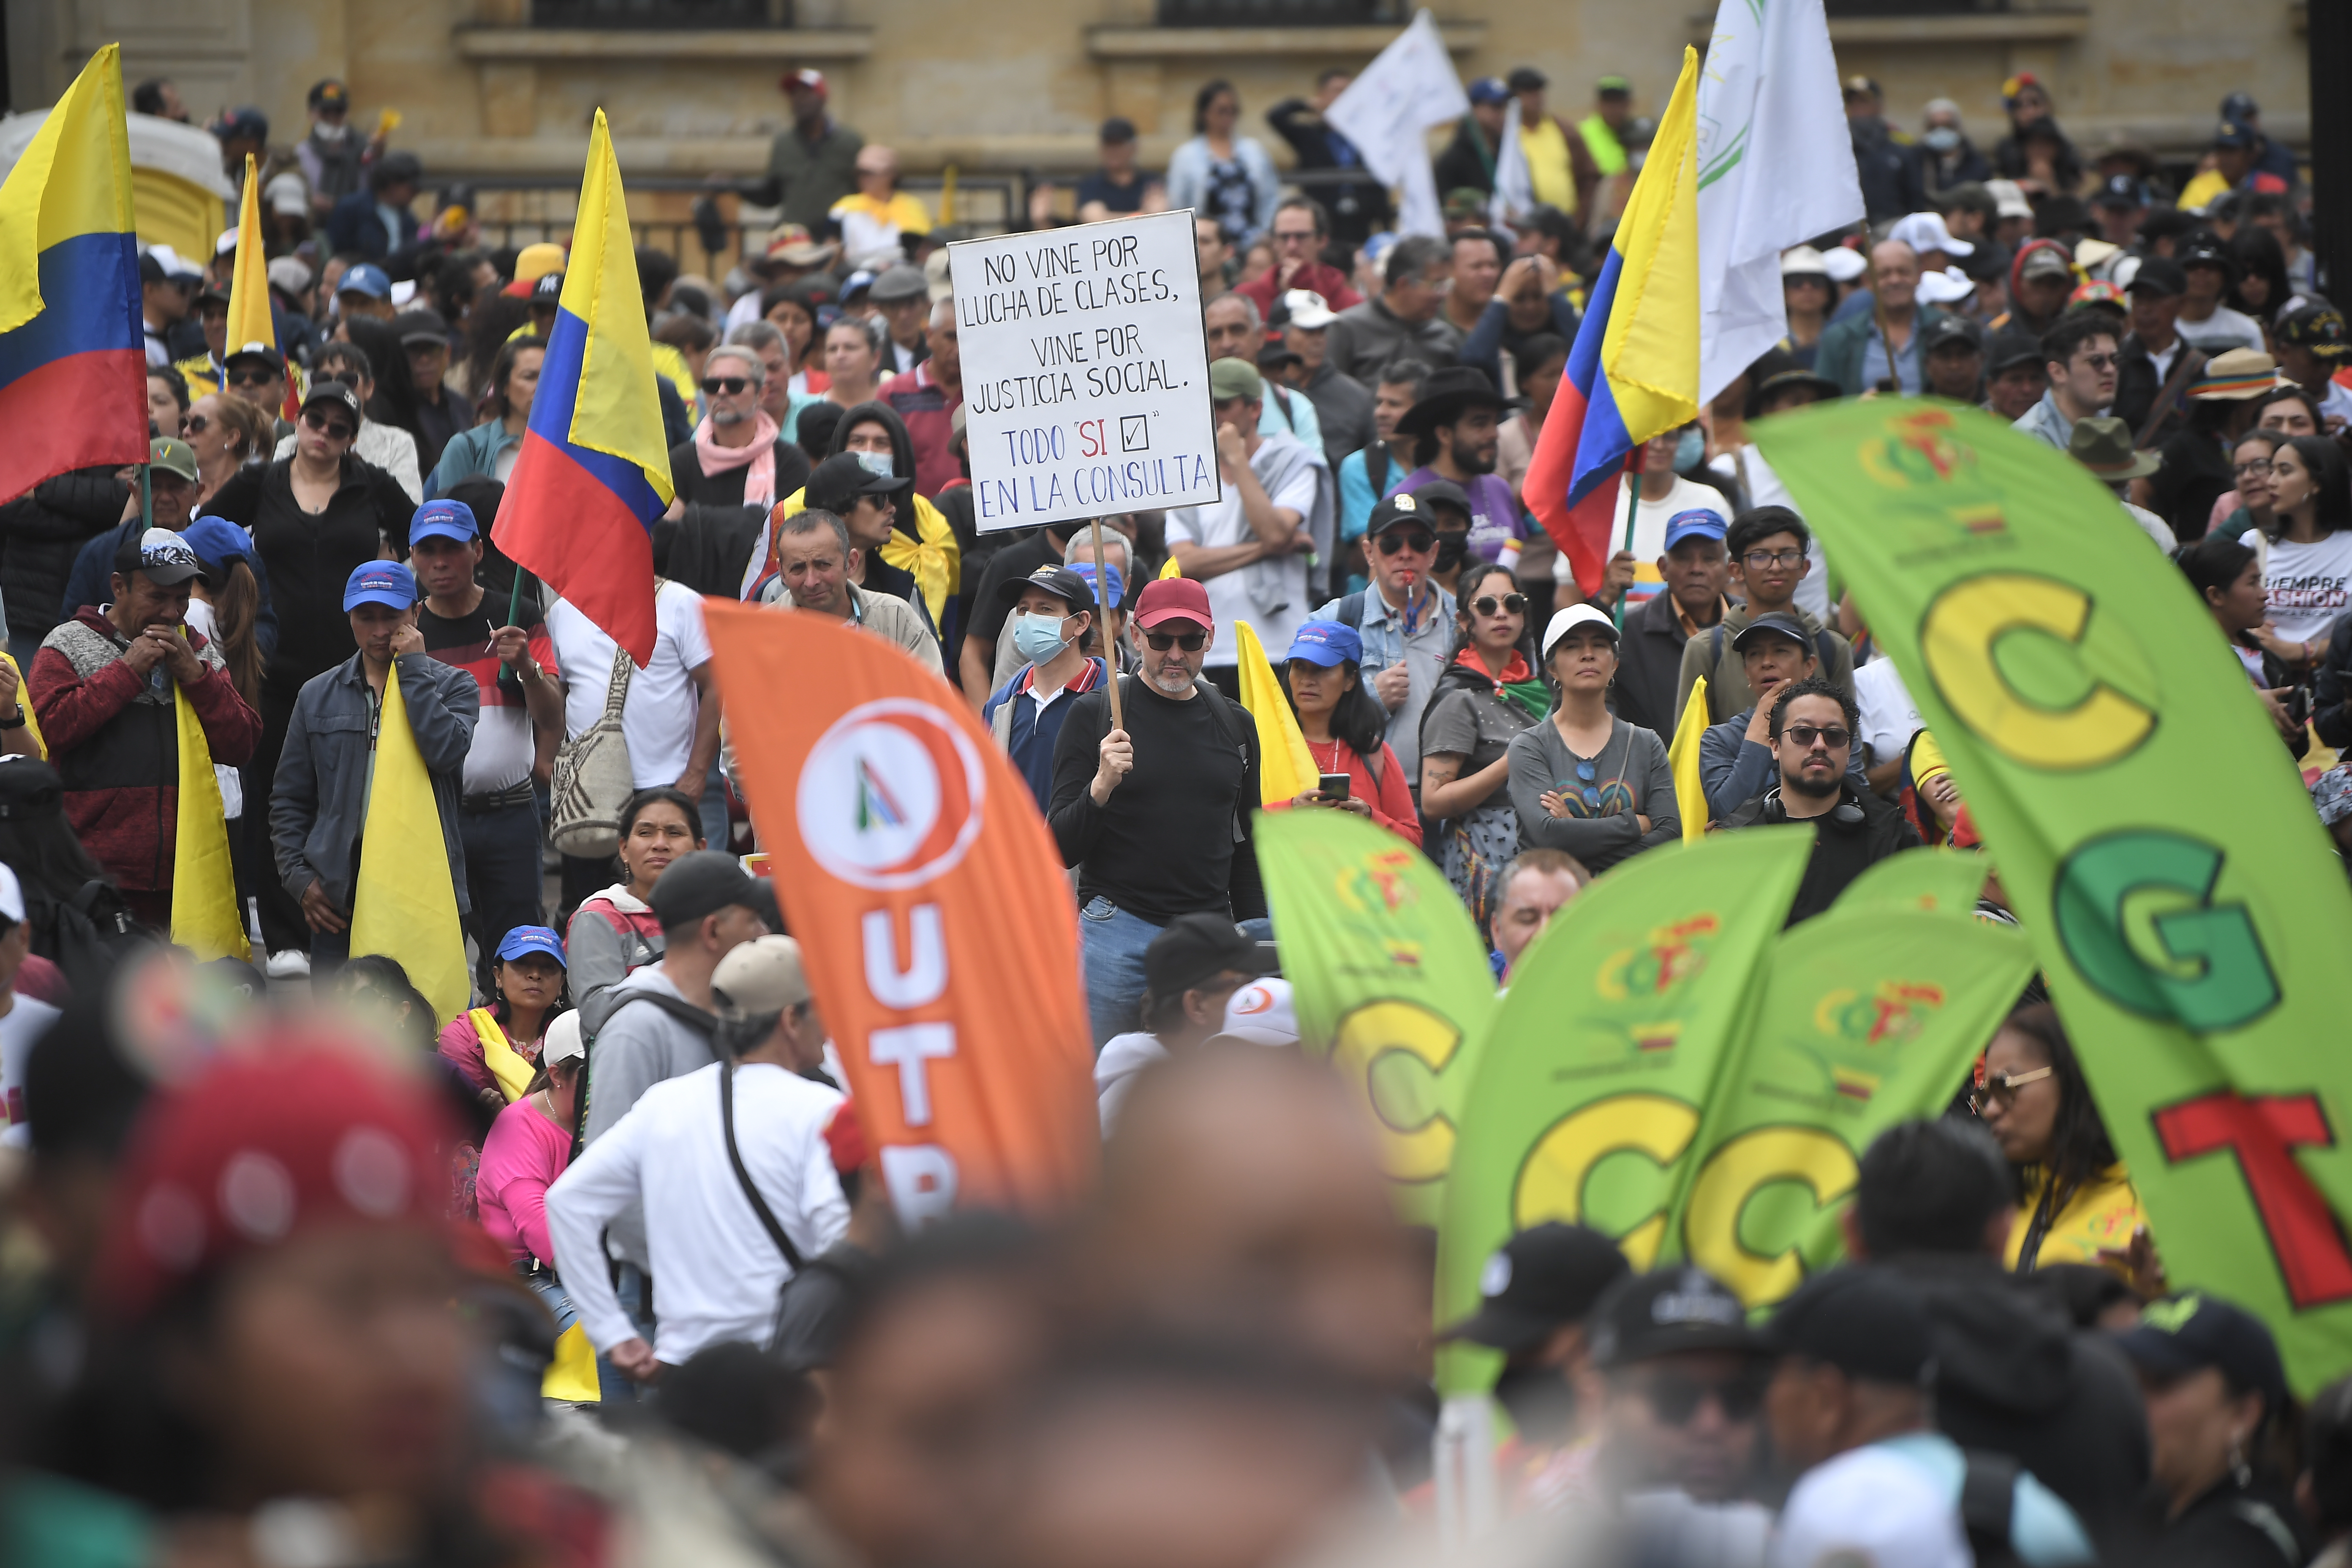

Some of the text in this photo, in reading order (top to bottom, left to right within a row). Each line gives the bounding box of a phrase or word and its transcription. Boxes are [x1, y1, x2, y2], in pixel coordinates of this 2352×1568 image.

[984, 235, 1140, 286] NO VINE POR
[961, 269, 1179, 327] LUCHA DE CLASES,
[1030, 324, 1144, 367] VINE POR
[972, 359, 1189, 414] JUSTICIA SOCIAL.
[1002, 425, 1065, 467] TODO
[979, 453, 1211, 518] EN LA CONSULTA
[2264, 591, 2348, 607] ASHION
